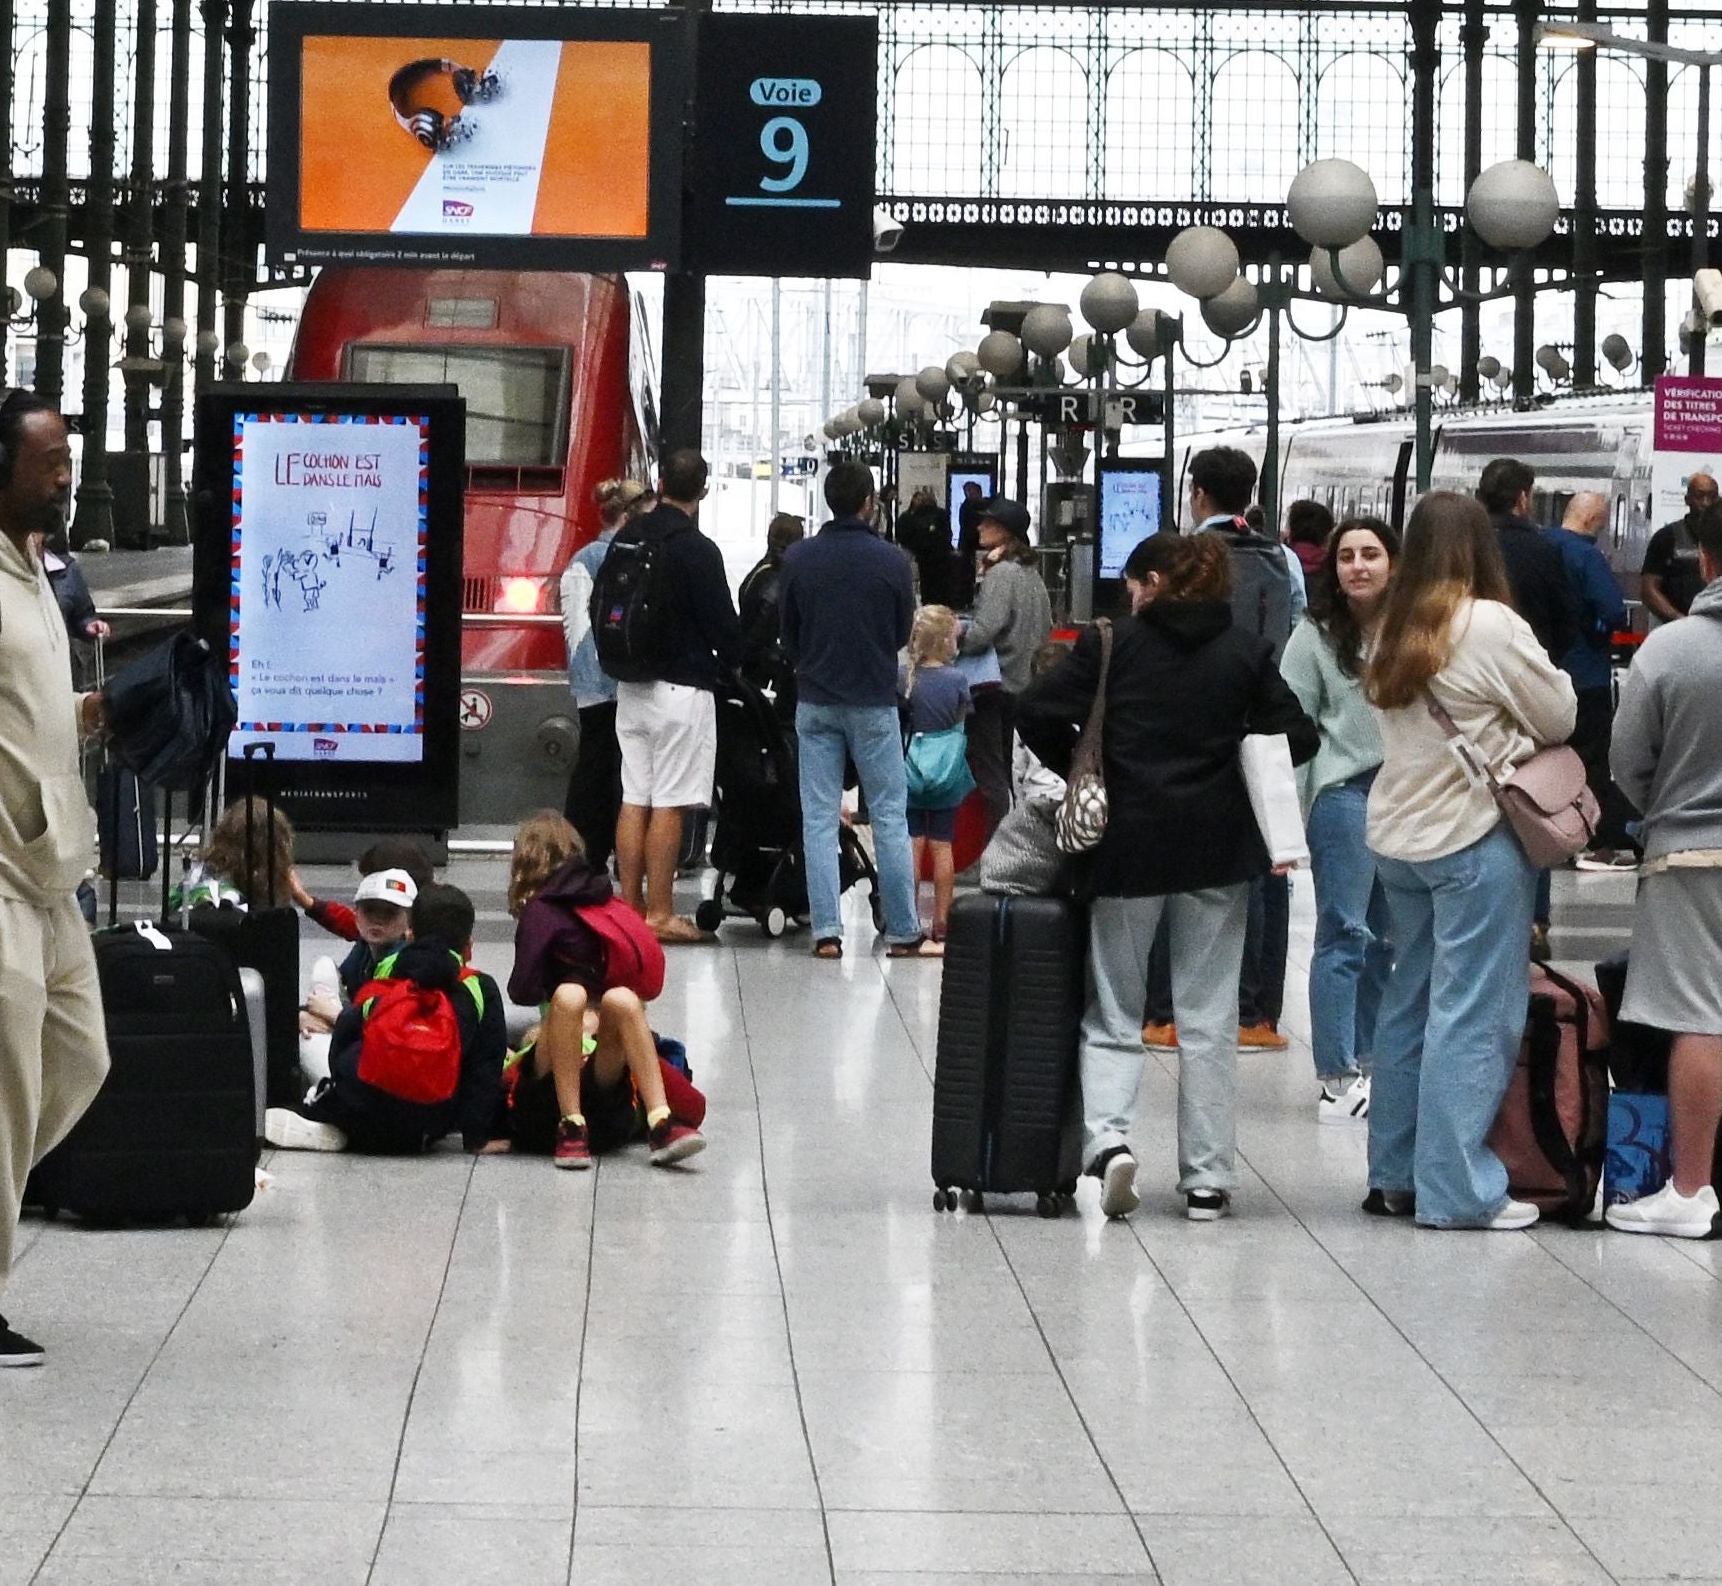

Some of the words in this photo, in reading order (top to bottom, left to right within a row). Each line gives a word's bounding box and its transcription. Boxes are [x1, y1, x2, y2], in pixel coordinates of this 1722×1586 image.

[759, 82, 812, 103] Voie
[759, 116, 809, 192] 9
[1061, 396, 1079, 422] R
[1121, 396, 1137, 422] R
[1663, 400, 1682, 409] DES
[1685, 401, 1717, 411] TITRES
[1663, 411, 1677, 421] DE
[898, 434, 909, 449] S
[275, 452, 301, 486] LE
[303, 453, 349, 469] COCHON
[355, 453, 382, 470] EST
[303, 473, 335, 487] DANS
[337, 474, 353, 487] LE
[251, 660, 265, 670] Eh
[259, 674, 271, 682] Le
[273, 674, 308, 683] cochon
[310, 674, 325, 683] est
[328, 674, 351, 684] dans
[353, 674, 362, 684] le
[251, 688, 262, 697] ça
[264, 688, 286, 696] vous
[288, 686, 303, 696] dit
[305, 687, 344, 698] quelque
[346, 687, 375, 697] chose
[280, 790, 368, 799] MEDIATRANSPORTS
